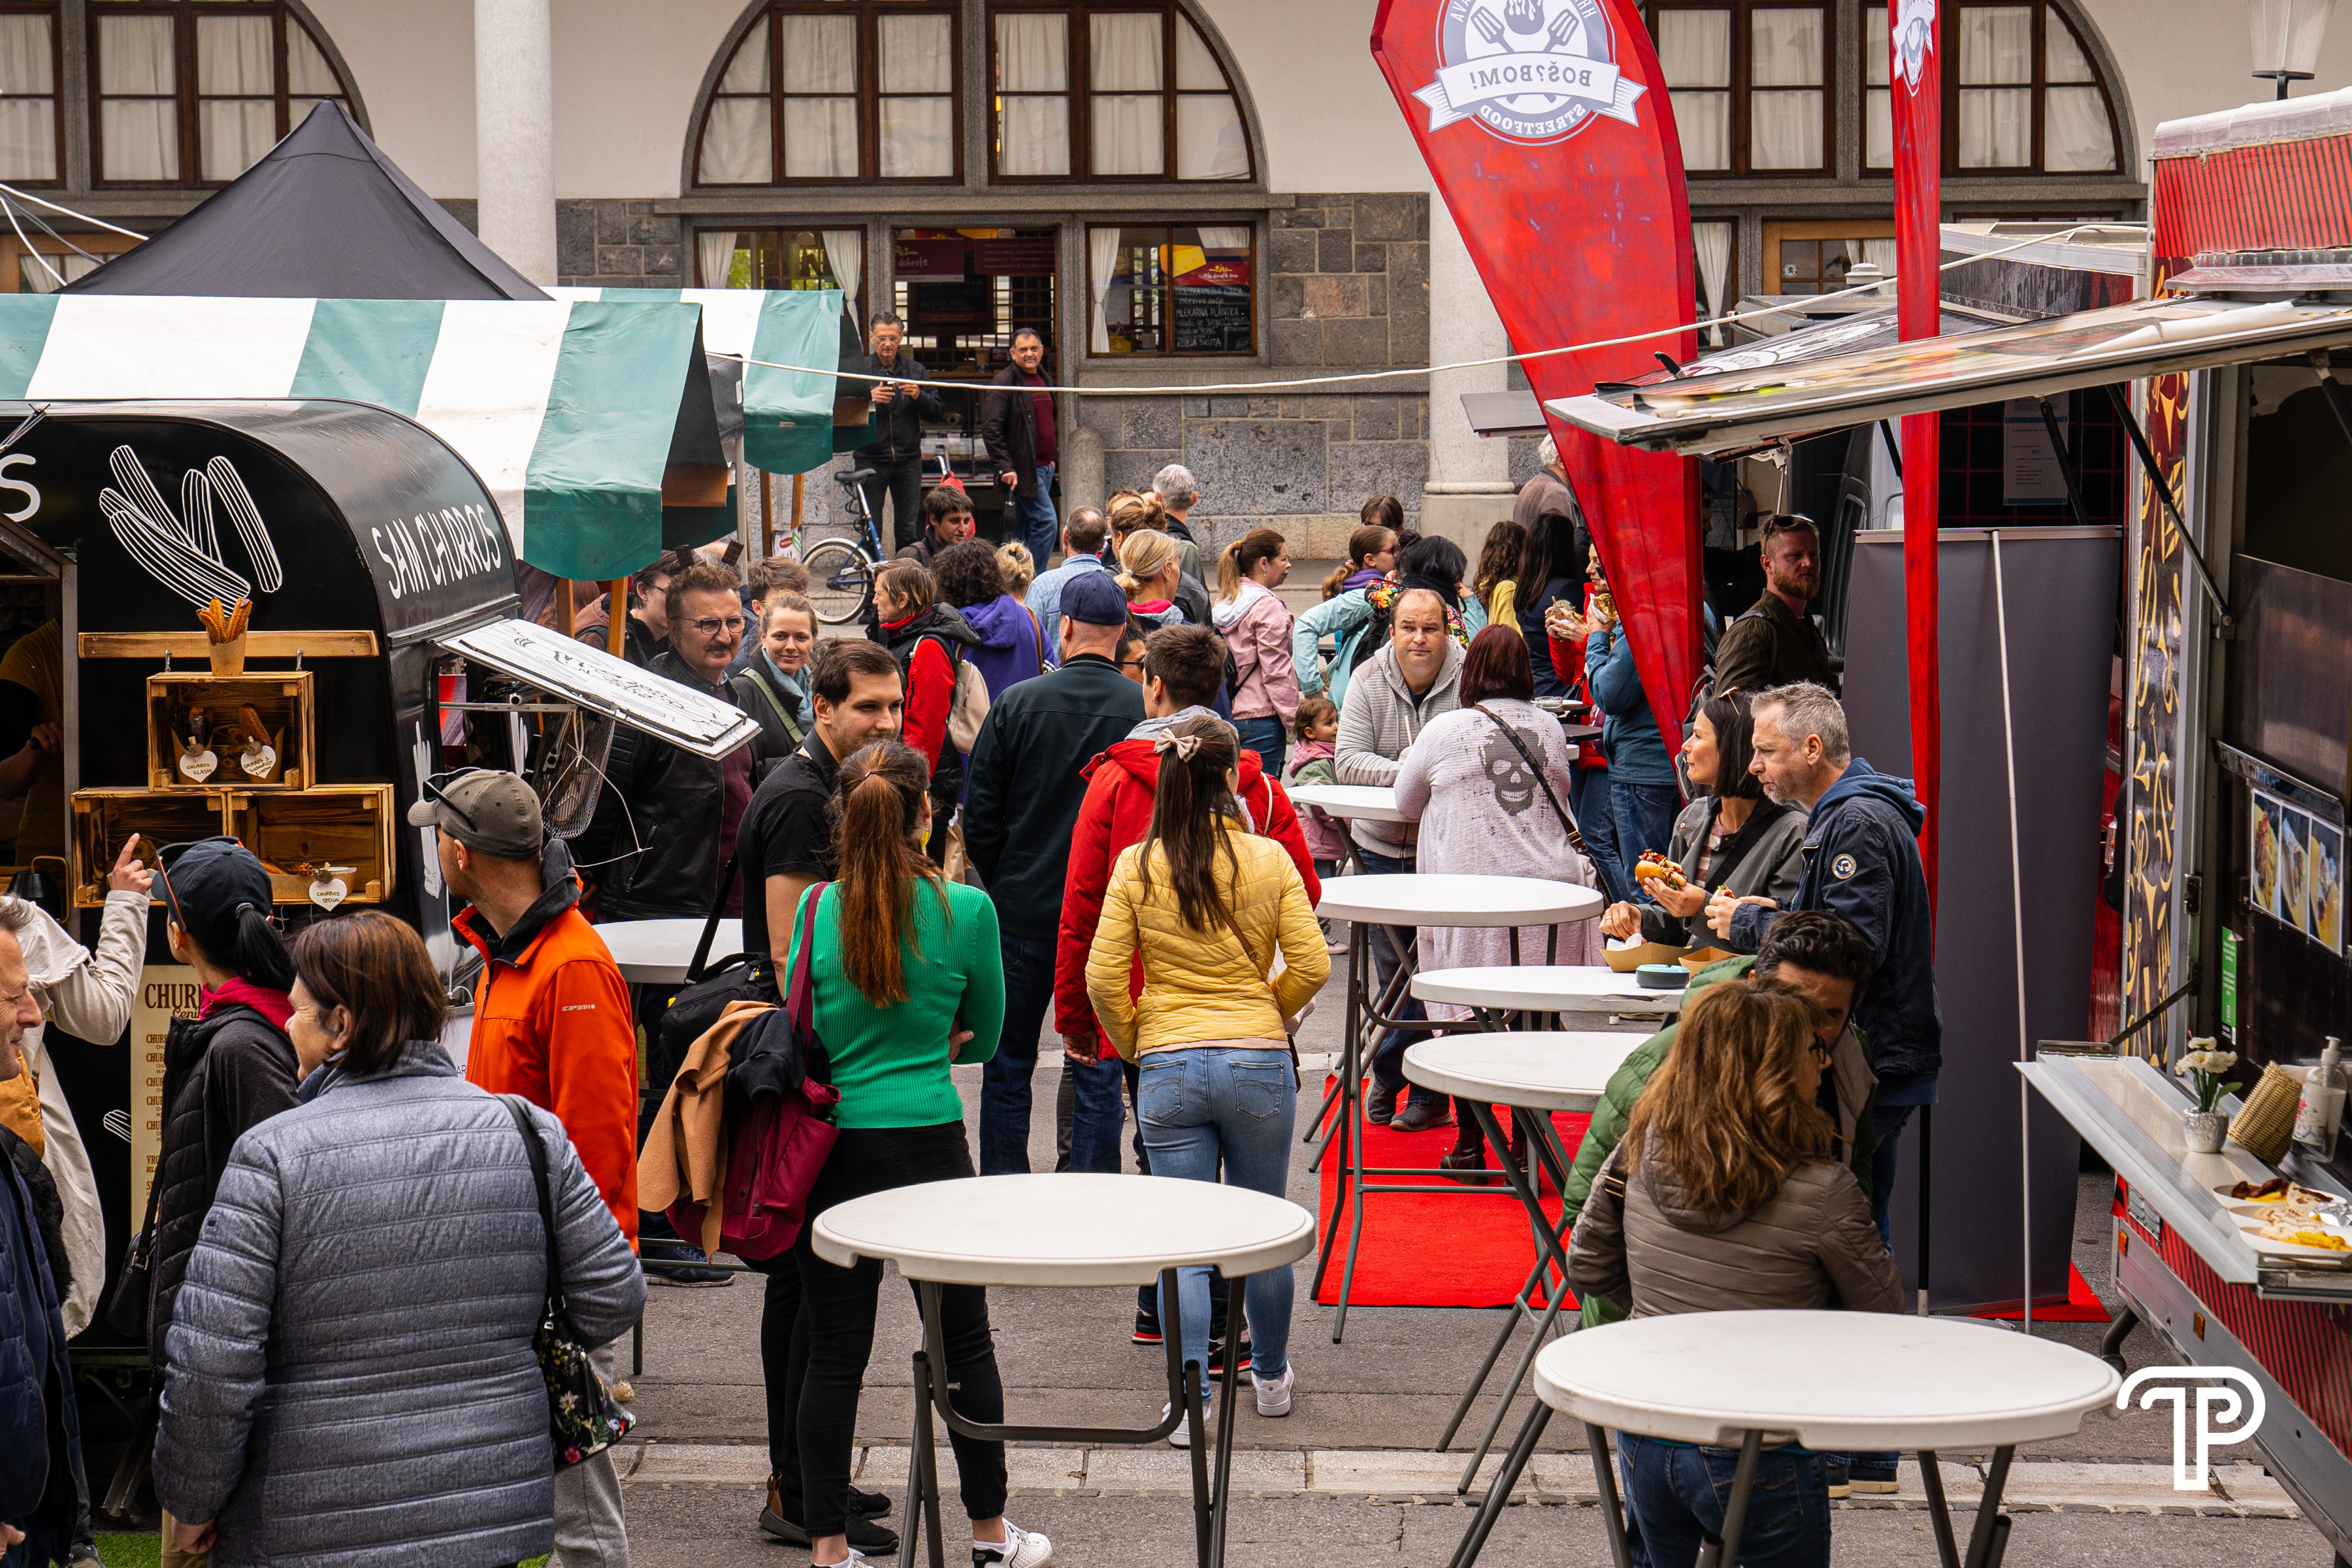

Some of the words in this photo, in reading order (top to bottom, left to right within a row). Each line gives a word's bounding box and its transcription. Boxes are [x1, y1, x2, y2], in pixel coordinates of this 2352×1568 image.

[898, 256, 928, 267] dobrote
[1176, 308, 1208, 318] MLEKARNA
[1210, 307, 1239, 317] PLANIKA
[1177, 338, 1197, 348] KOZJA
[1200, 337, 1221, 347] SKUTA
[371, 518, 431, 600] SAM
[415, 504, 501, 586] CHURROS
